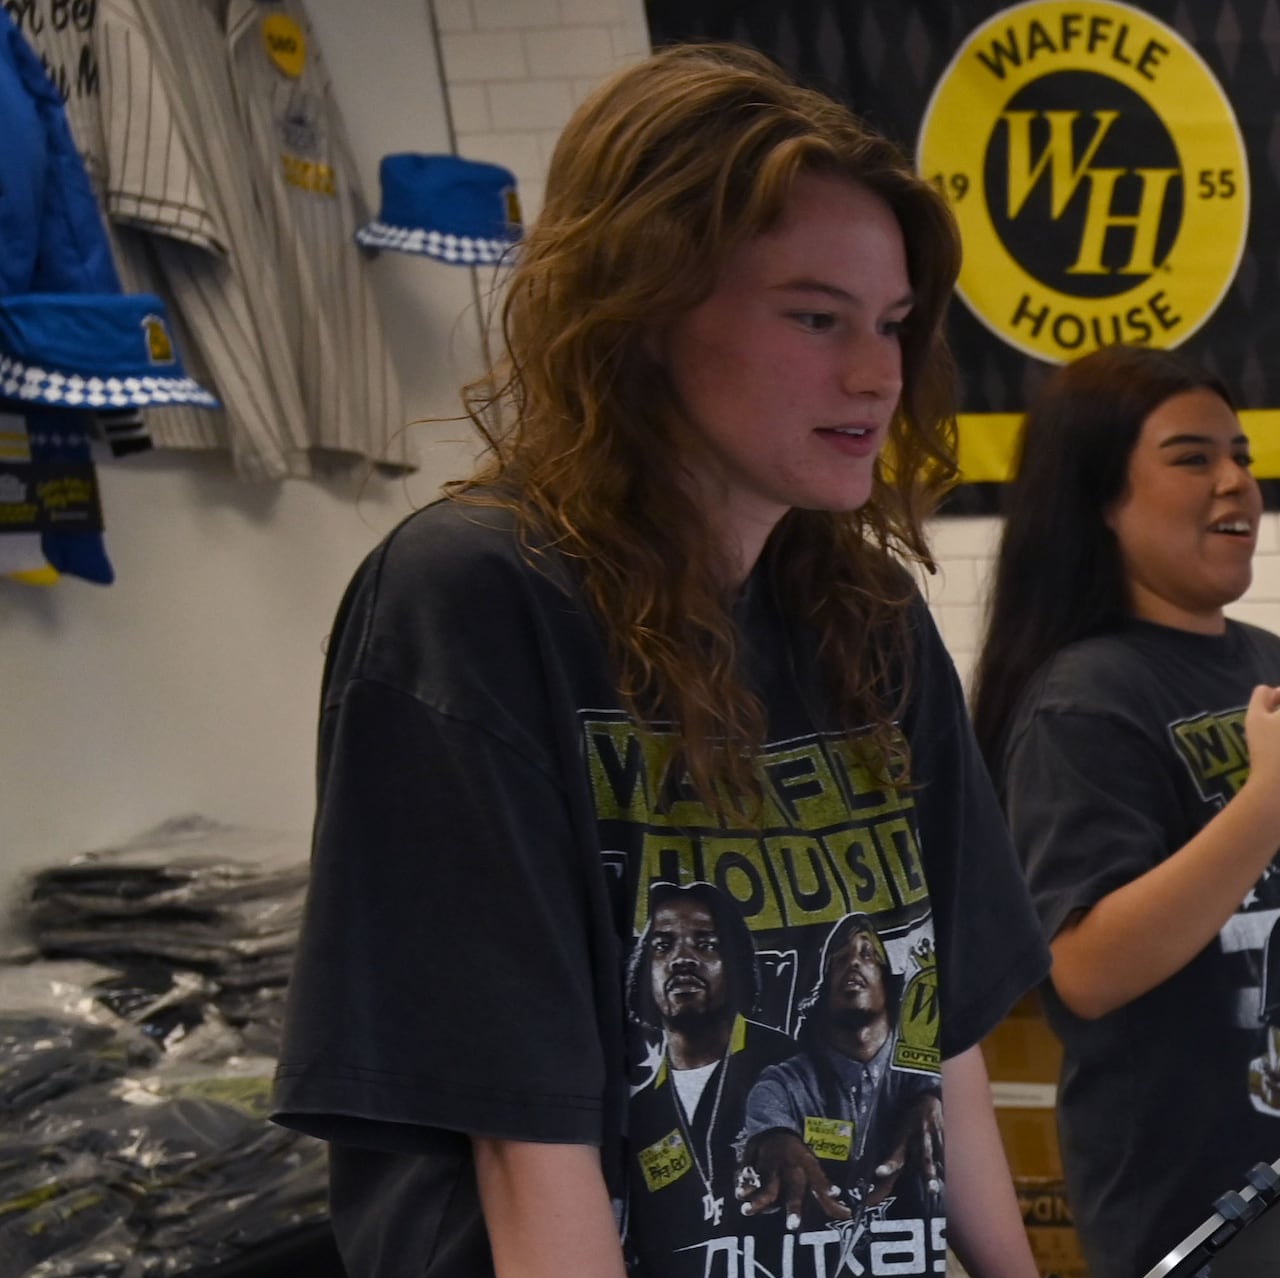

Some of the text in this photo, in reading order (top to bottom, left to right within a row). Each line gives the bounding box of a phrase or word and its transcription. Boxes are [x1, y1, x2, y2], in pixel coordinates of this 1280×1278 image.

[975, 13, 1169, 81] WAFFLE
[1198, 169, 1236, 199] 55
[1011, 291, 1181, 350] HOUSE
